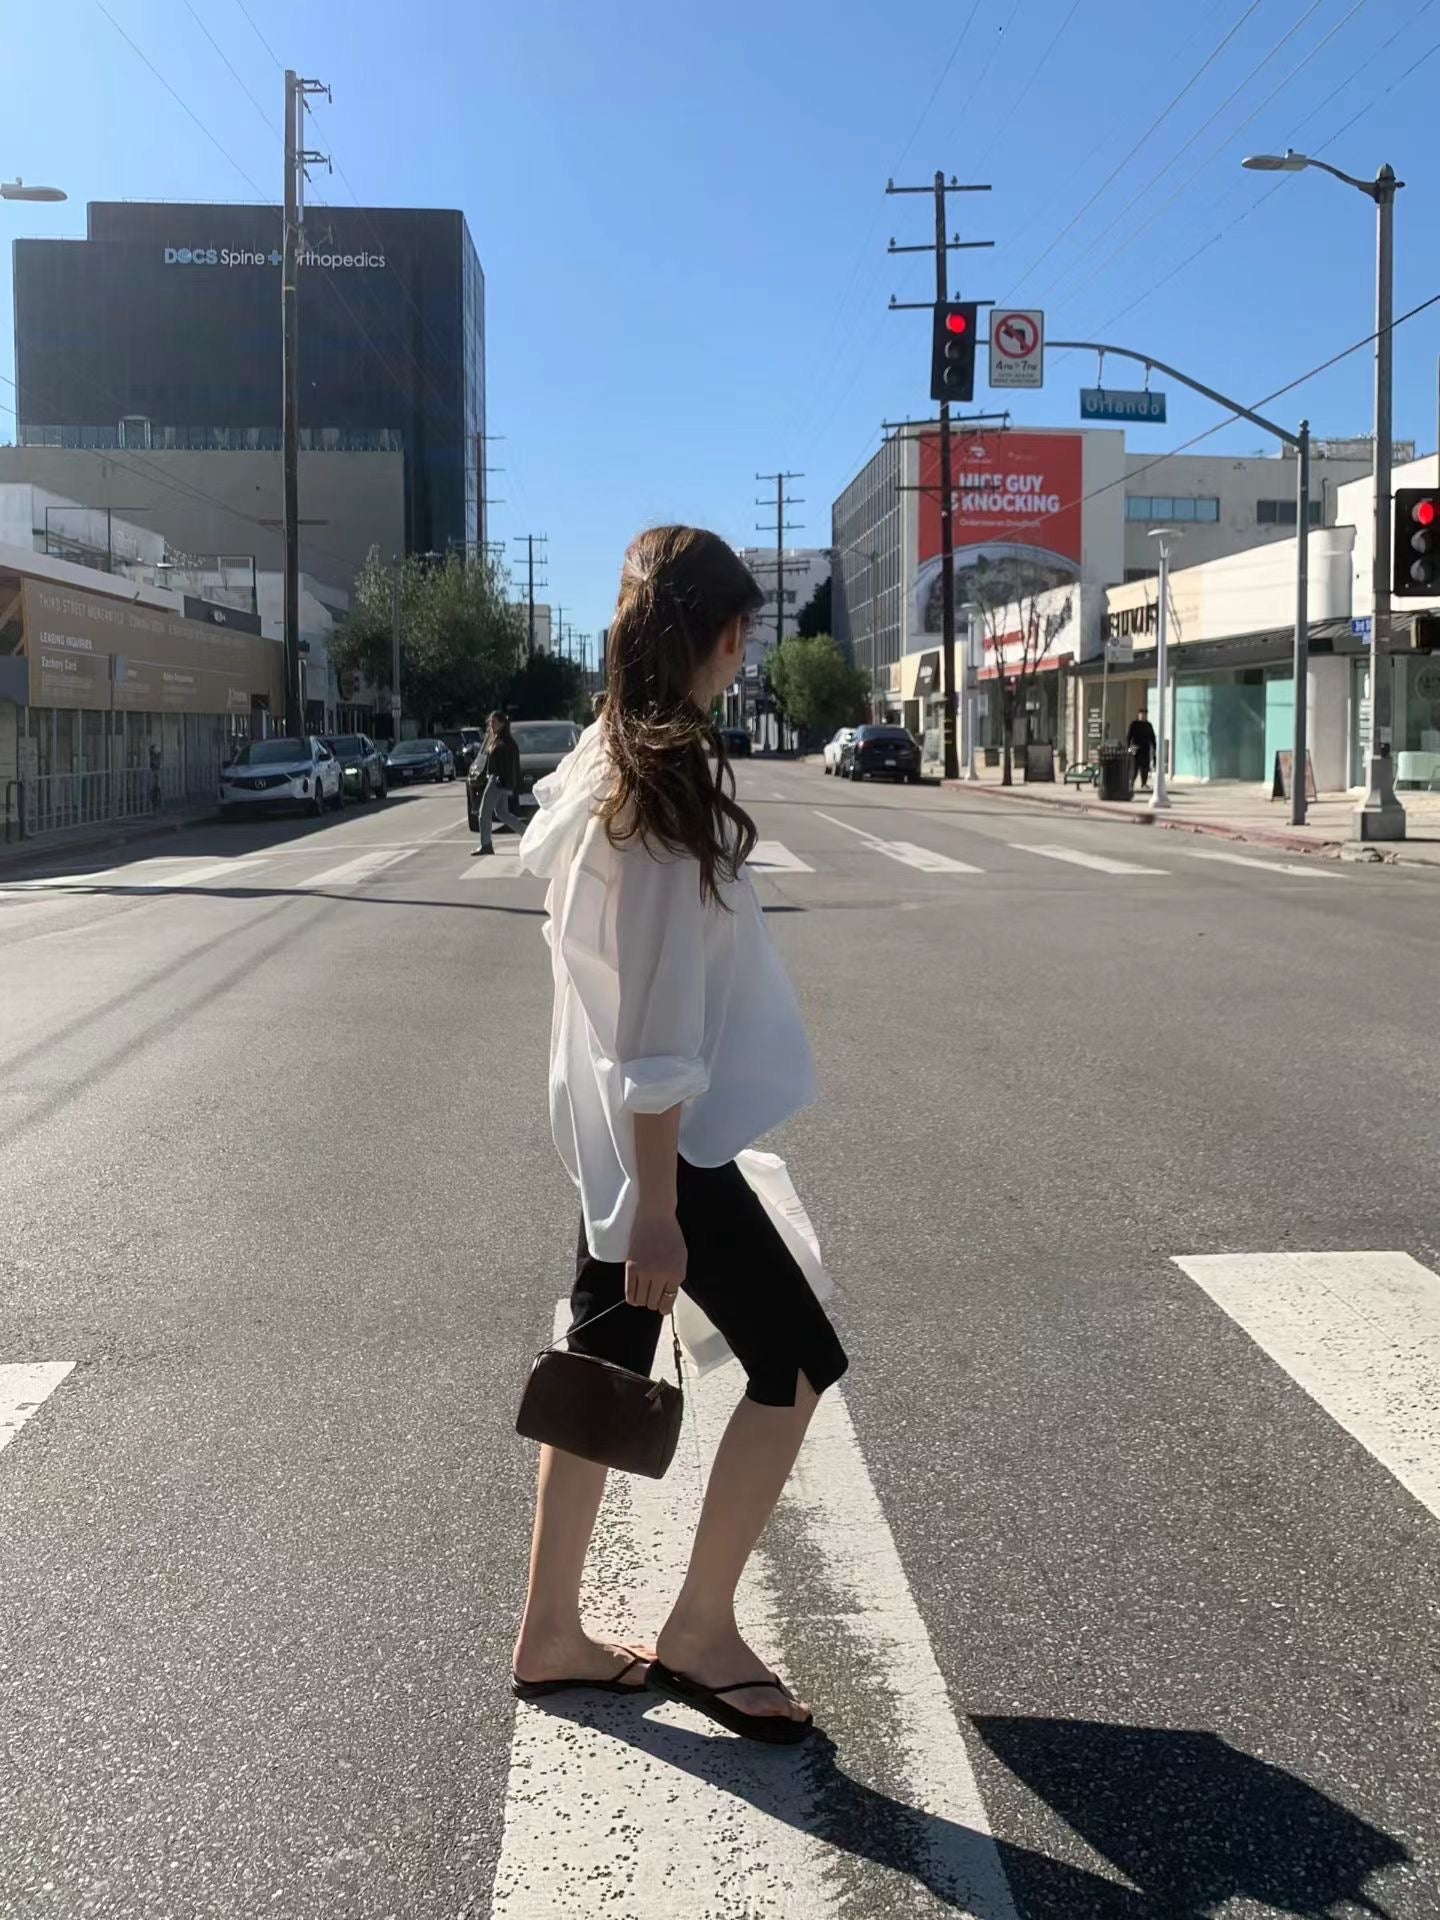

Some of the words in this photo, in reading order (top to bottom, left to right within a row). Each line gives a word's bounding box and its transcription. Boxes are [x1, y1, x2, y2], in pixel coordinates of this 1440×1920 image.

[165, 248, 217, 264] DOCS
[220, 249, 265, 267] Spine
[297, 251, 386, 269] rthopedics
[1086, 396, 1160, 416] Orlando
[1006, 474, 1043, 493] GUY
[962, 492, 1060, 512] KNOCKING
[40, 632, 65, 646] LEASING
